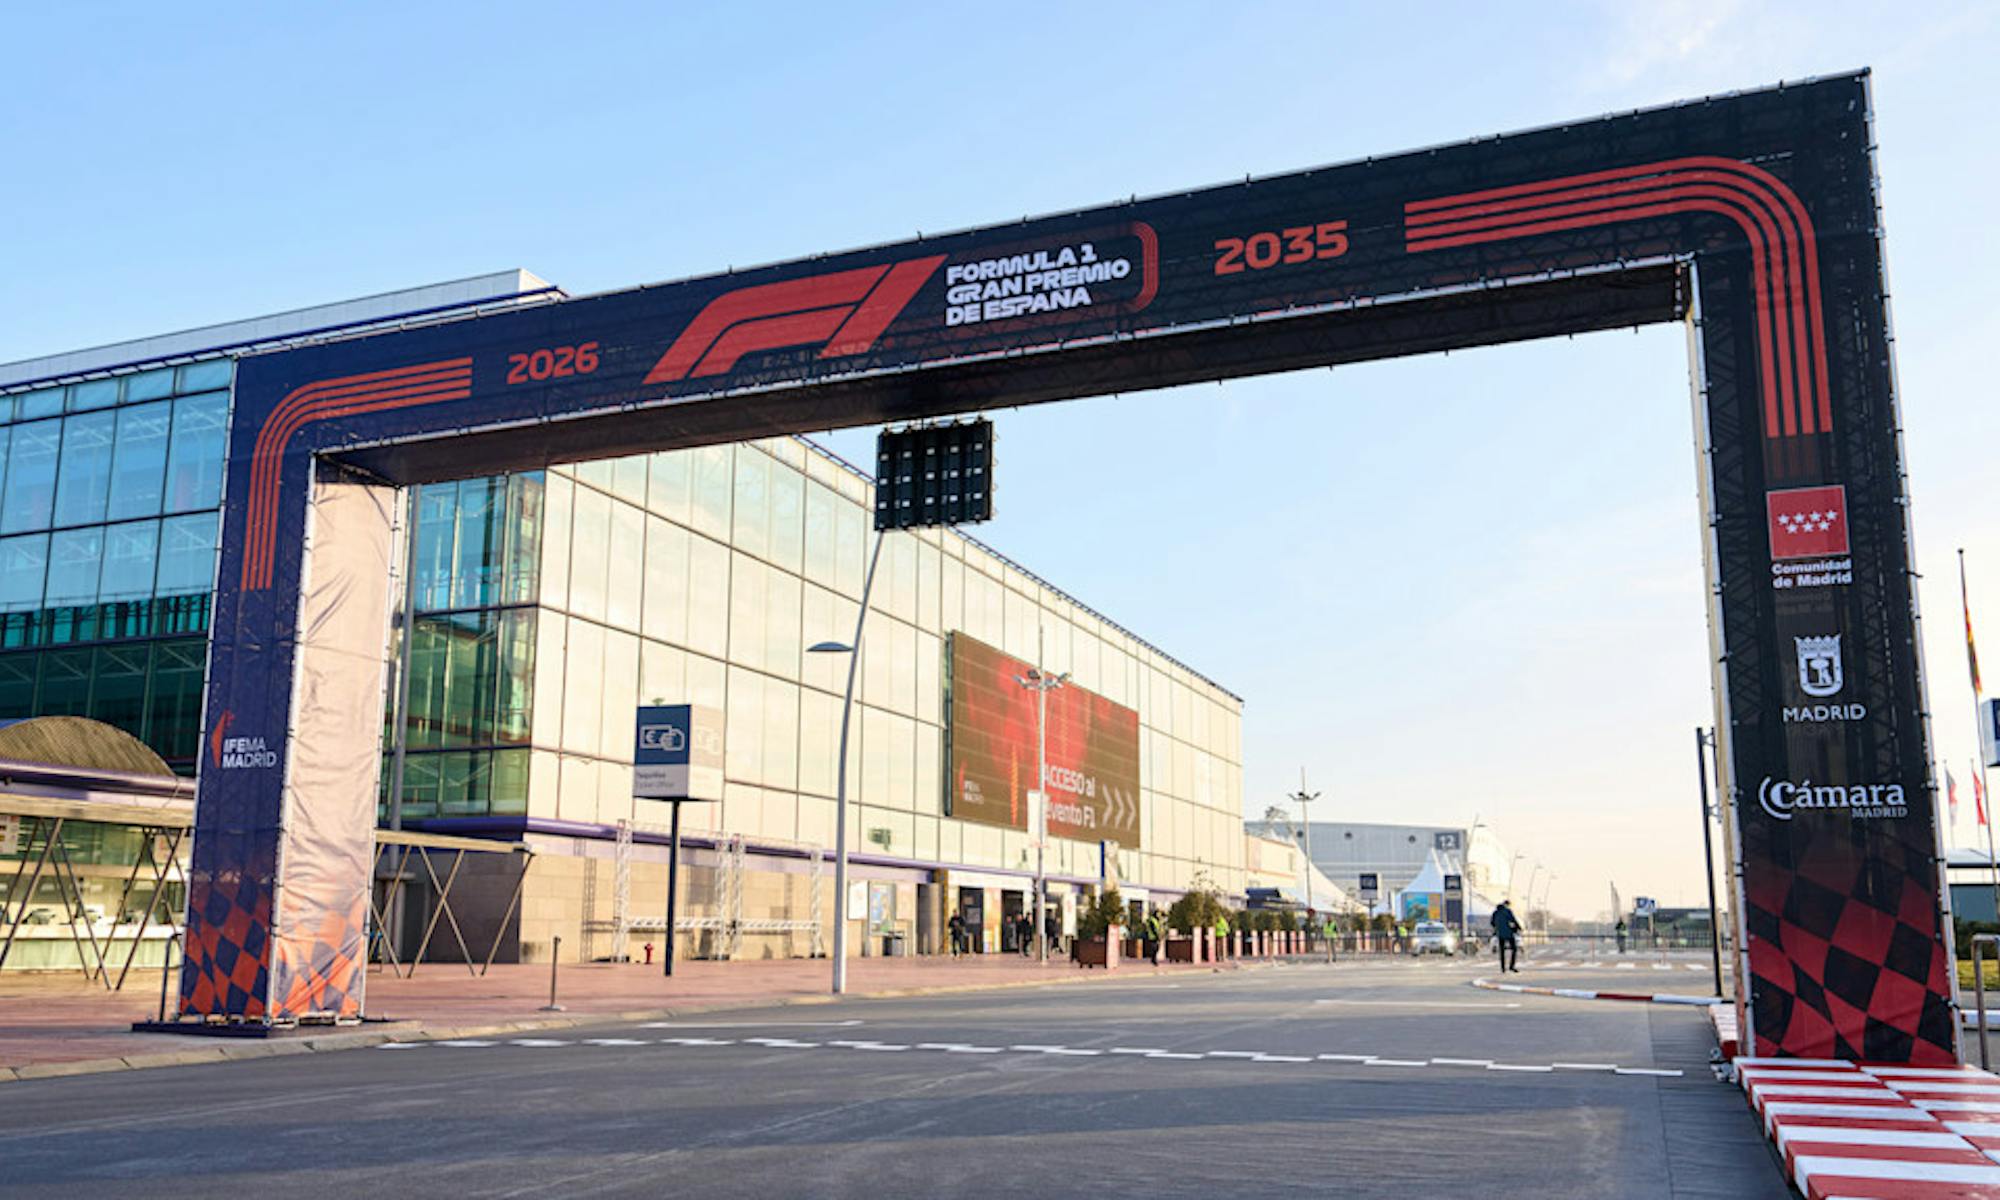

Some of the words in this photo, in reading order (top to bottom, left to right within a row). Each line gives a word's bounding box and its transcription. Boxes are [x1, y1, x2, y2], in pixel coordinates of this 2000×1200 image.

[1214, 219, 1349, 276] 2035
[946, 246, 1077, 285] FORMULA
[1080, 243, 1098, 263] 1
[946, 276, 1023, 305] GRAN
[1024, 258, 1131, 293] PREMIO
[945, 304, 981, 327] DE
[506, 341, 600, 385] 2026
[1771, 558, 1852, 575] Comunidad
[1772, 576, 1793, 589] de
[1797, 571, 1852, 587] Madrid
[1782, 703, 1867, 723] MADRID
[223, 736, 267, 753] IFEMA
[222, 751, 277, 769] MADRID
[1085, 776, 1096, 799] al
[1767, 778, 1907, 810] Cámara
[1851, 807, 1908, 819] MADRID
[1439, 835, 1455, 847] 12
